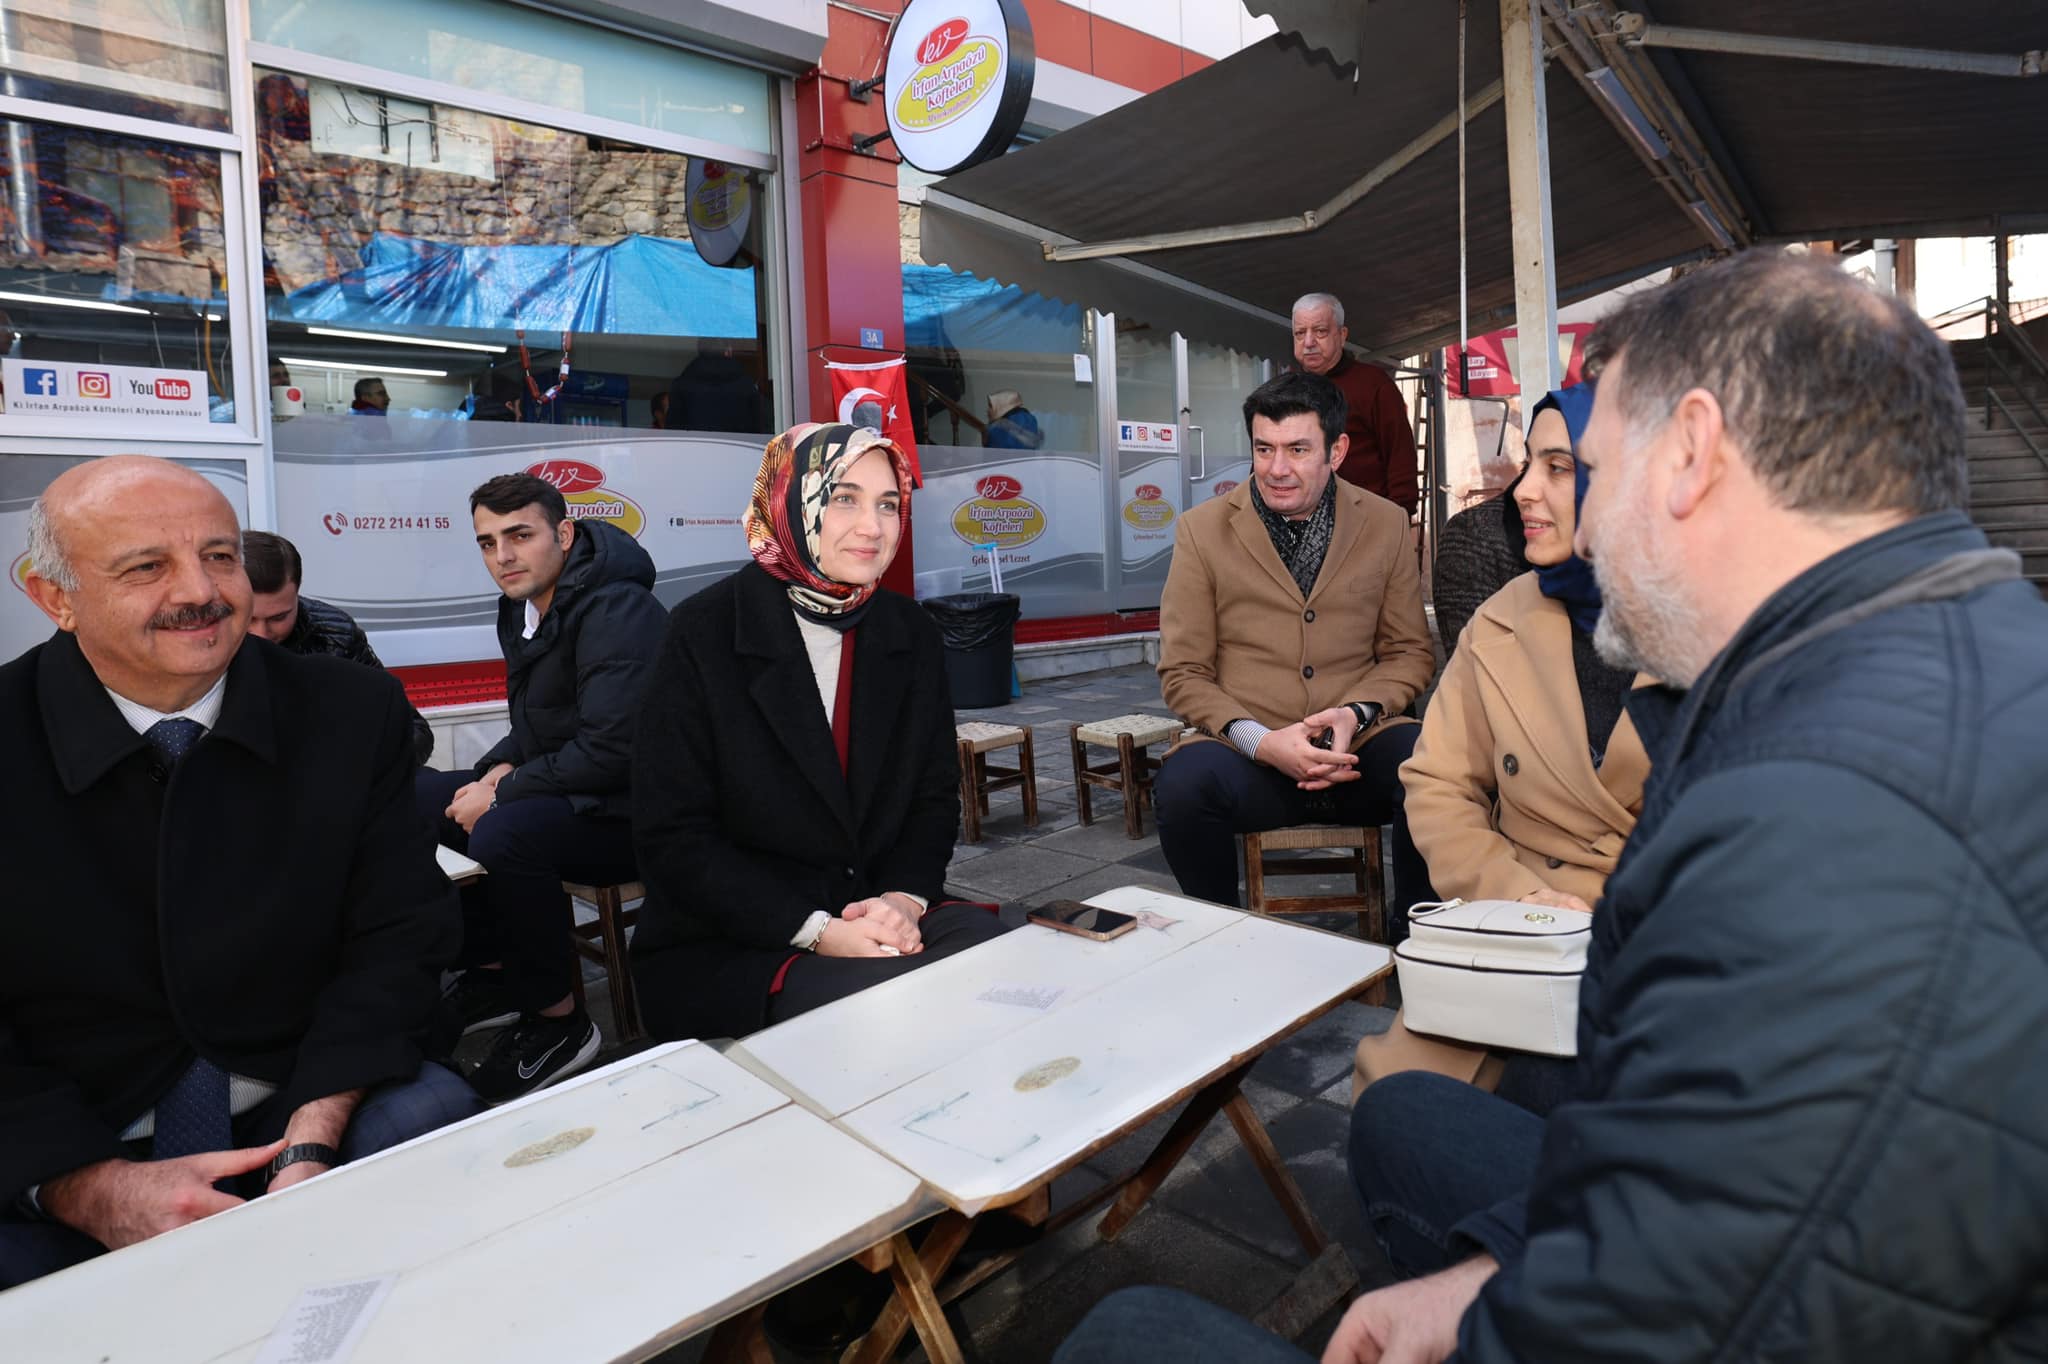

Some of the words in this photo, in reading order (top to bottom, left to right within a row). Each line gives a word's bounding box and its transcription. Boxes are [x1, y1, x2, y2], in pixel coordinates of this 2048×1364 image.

[941, 45, 986, 80] Arpaözü
[928, 71, 974, 108] Köfteleri
[866, 331, 879, 343] 3A
[129, 379, 190, 400] YouTube
[995, 506, 1034, 521] Arpaözü
[354, 517, 385, 529] 0272
[390, 517, 412, 529] 214
[416, 517, 430, 529] 41
[435, 517, 450, 529] 55
[983, 521, 1023, 535] Köfteleri
